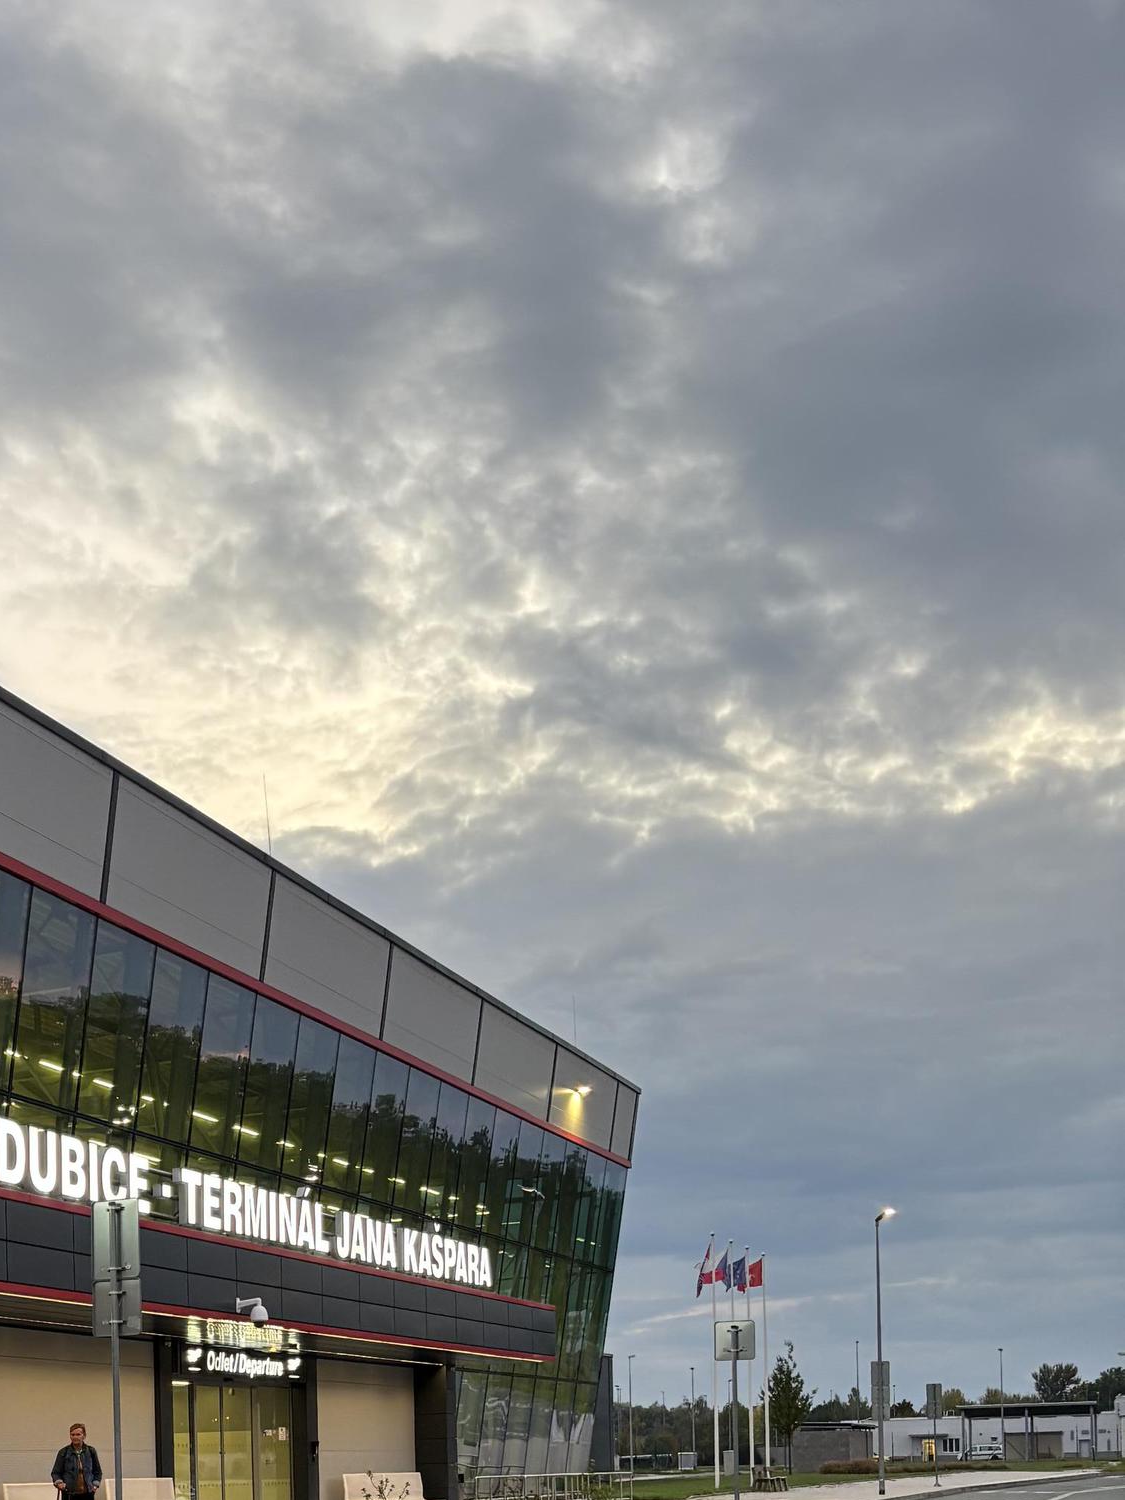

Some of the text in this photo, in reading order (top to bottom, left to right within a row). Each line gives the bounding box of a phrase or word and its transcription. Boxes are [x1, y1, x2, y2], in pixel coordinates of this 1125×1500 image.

[177, 1167, 331, 1253] TERMINÁL
[335, 1210, 398, 1269] JANA
[403, 1222, 493, 1288] KAŠPARA
[206, 1350, 234, 1373] Odlet
[238, 1353, 284, 1379] Departure
